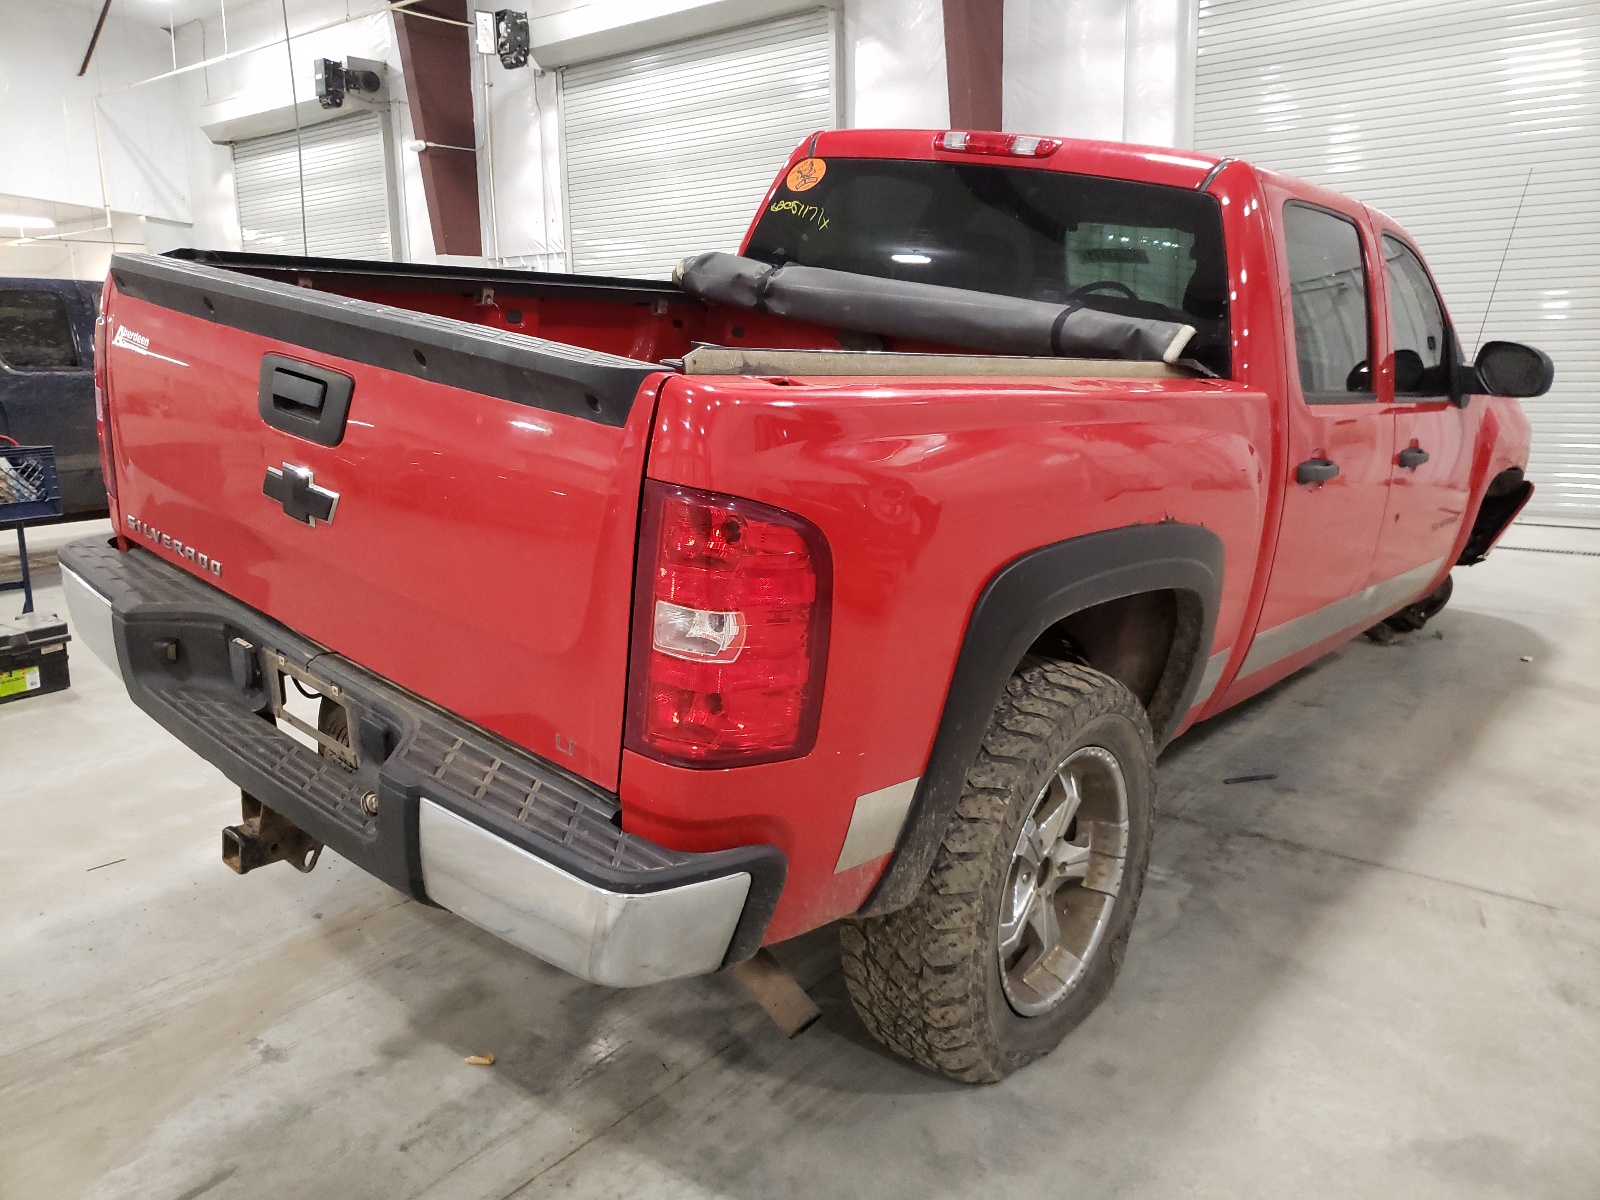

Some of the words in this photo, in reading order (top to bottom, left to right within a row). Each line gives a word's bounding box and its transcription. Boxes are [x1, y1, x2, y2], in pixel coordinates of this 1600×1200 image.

[111, 324, 150, 347] Aberdeen
[127, 514, 222, 577] SILVERADO
[555, 733, 577, 756] LT
